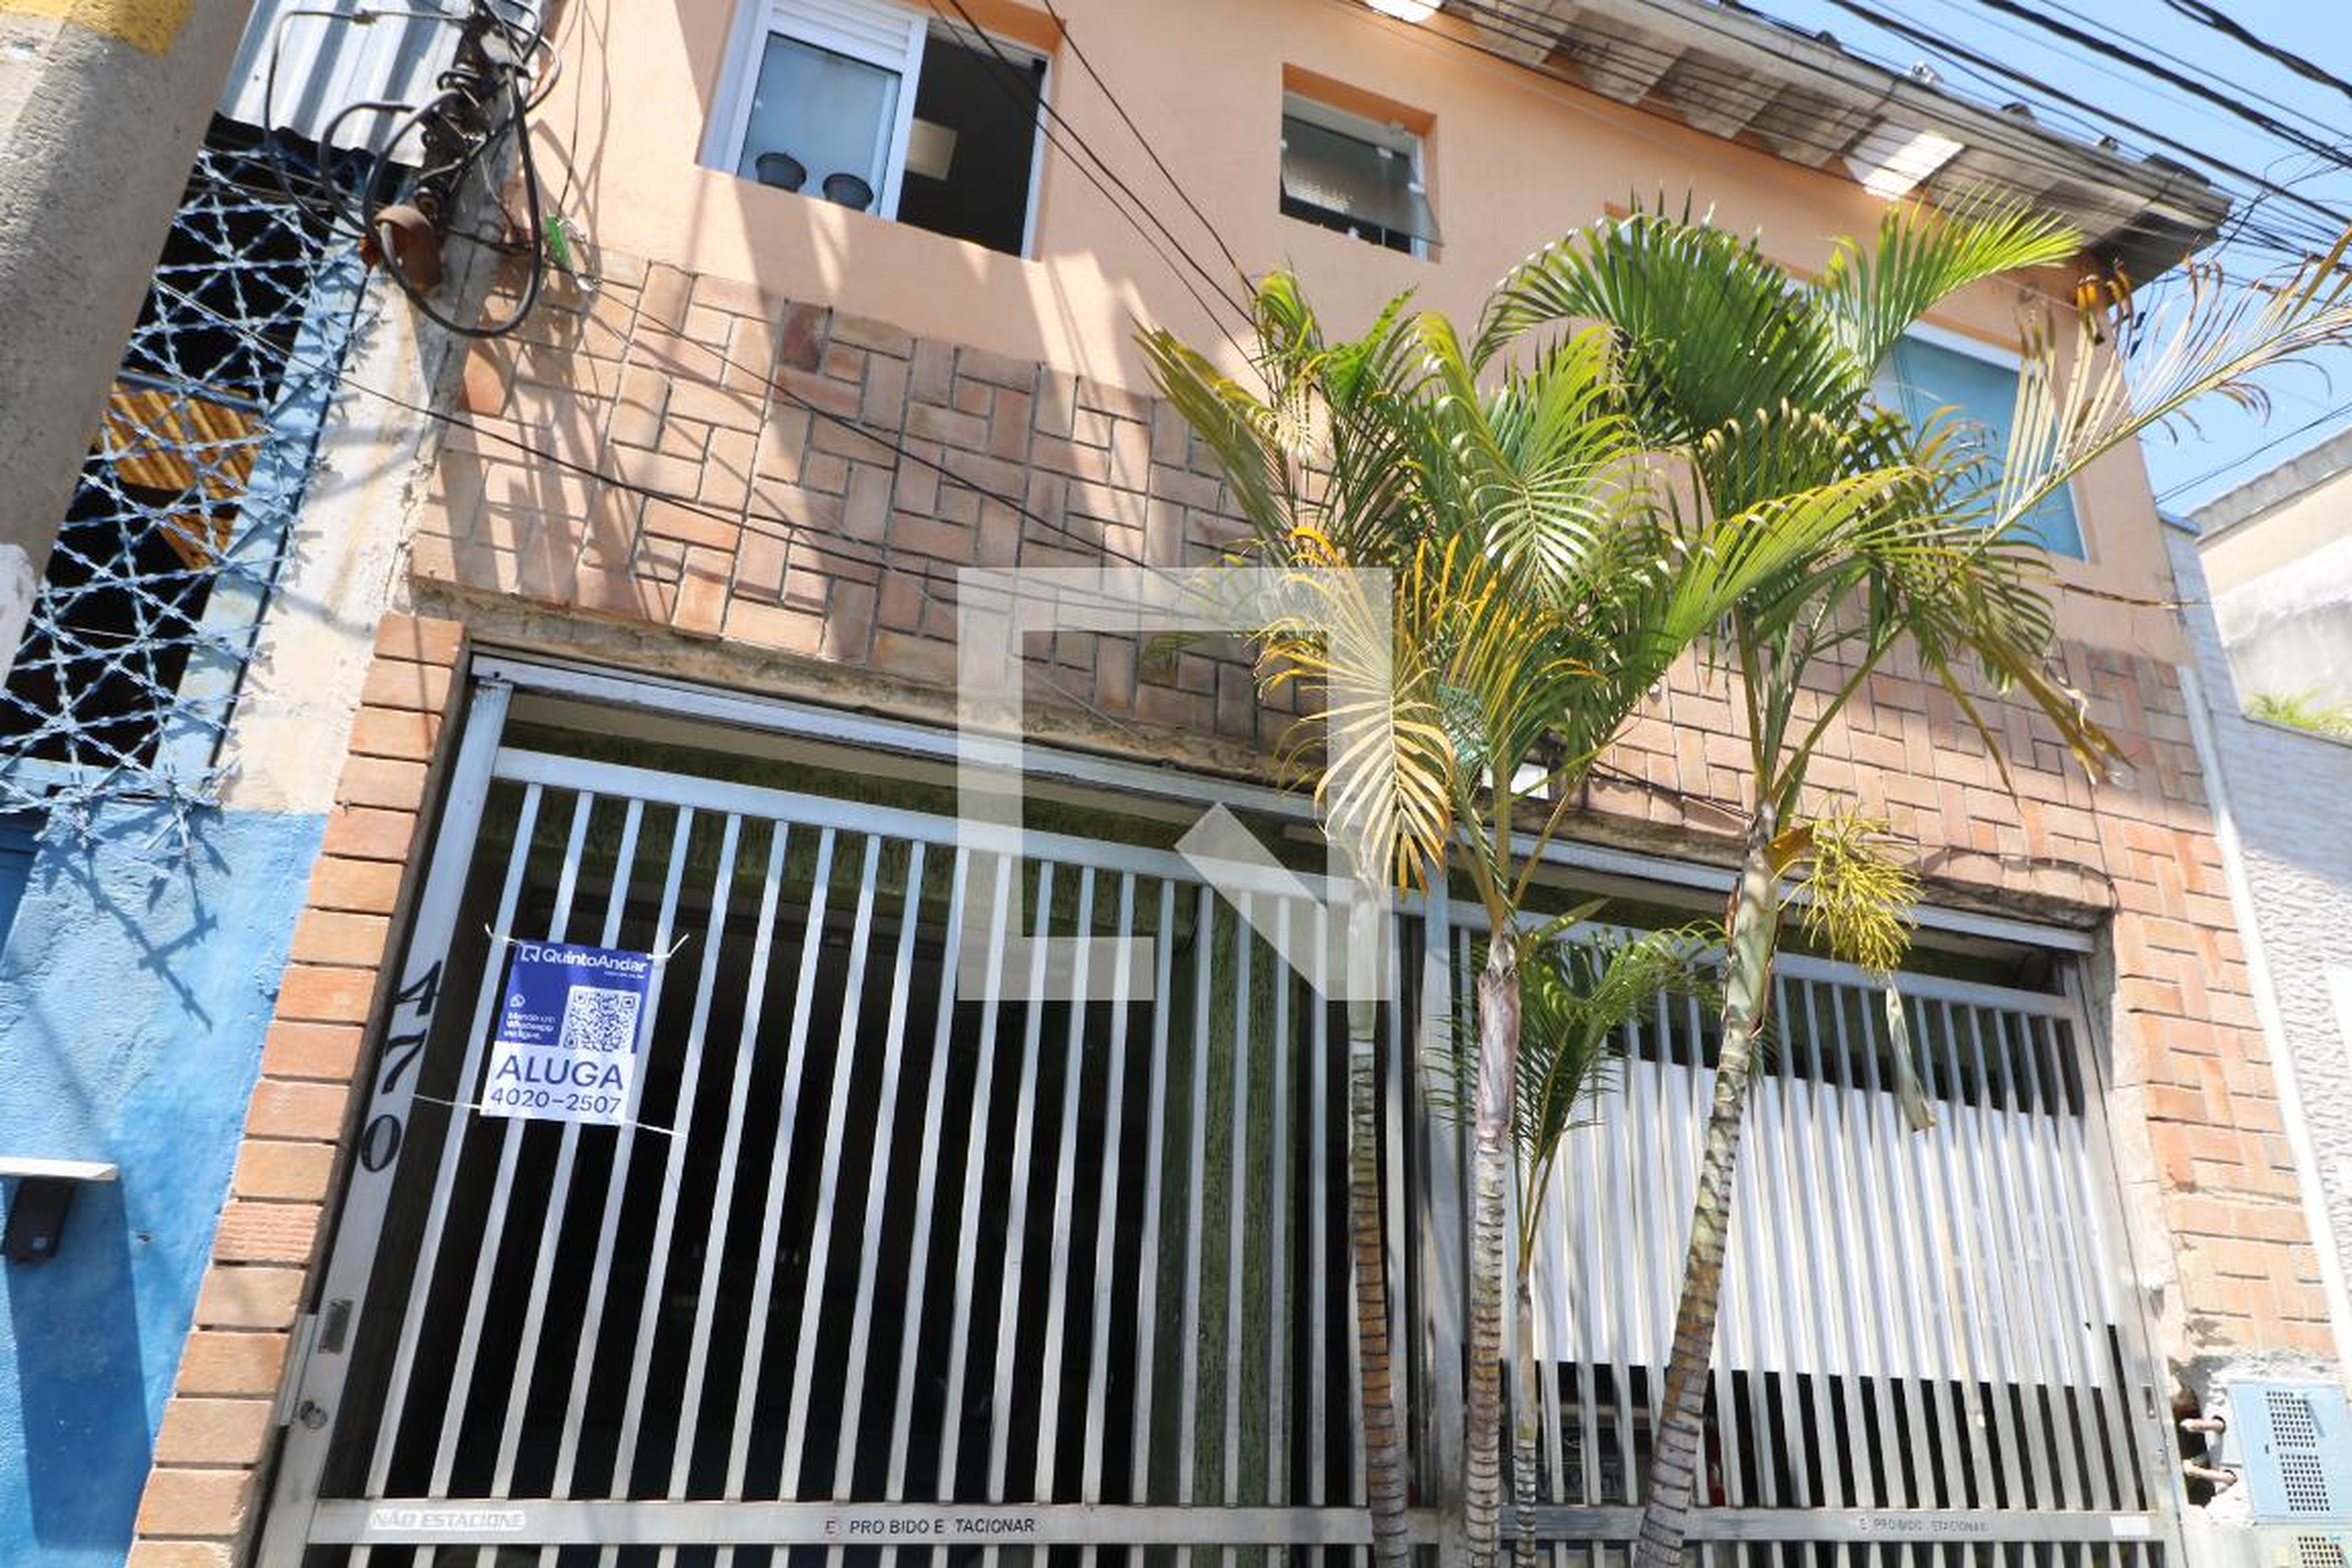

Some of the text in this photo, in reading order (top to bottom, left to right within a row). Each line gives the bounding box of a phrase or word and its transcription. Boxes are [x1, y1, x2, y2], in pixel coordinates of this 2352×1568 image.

[541, 948, 648, 973] QuintoAndar
[360, 960, 442, 1172] 470
[496, 1055, 624, 1090] ALUGA
[491, 1087, 621, 1114] 4020-2507
[421, 1512, 525, 1528] ESTACIONE
